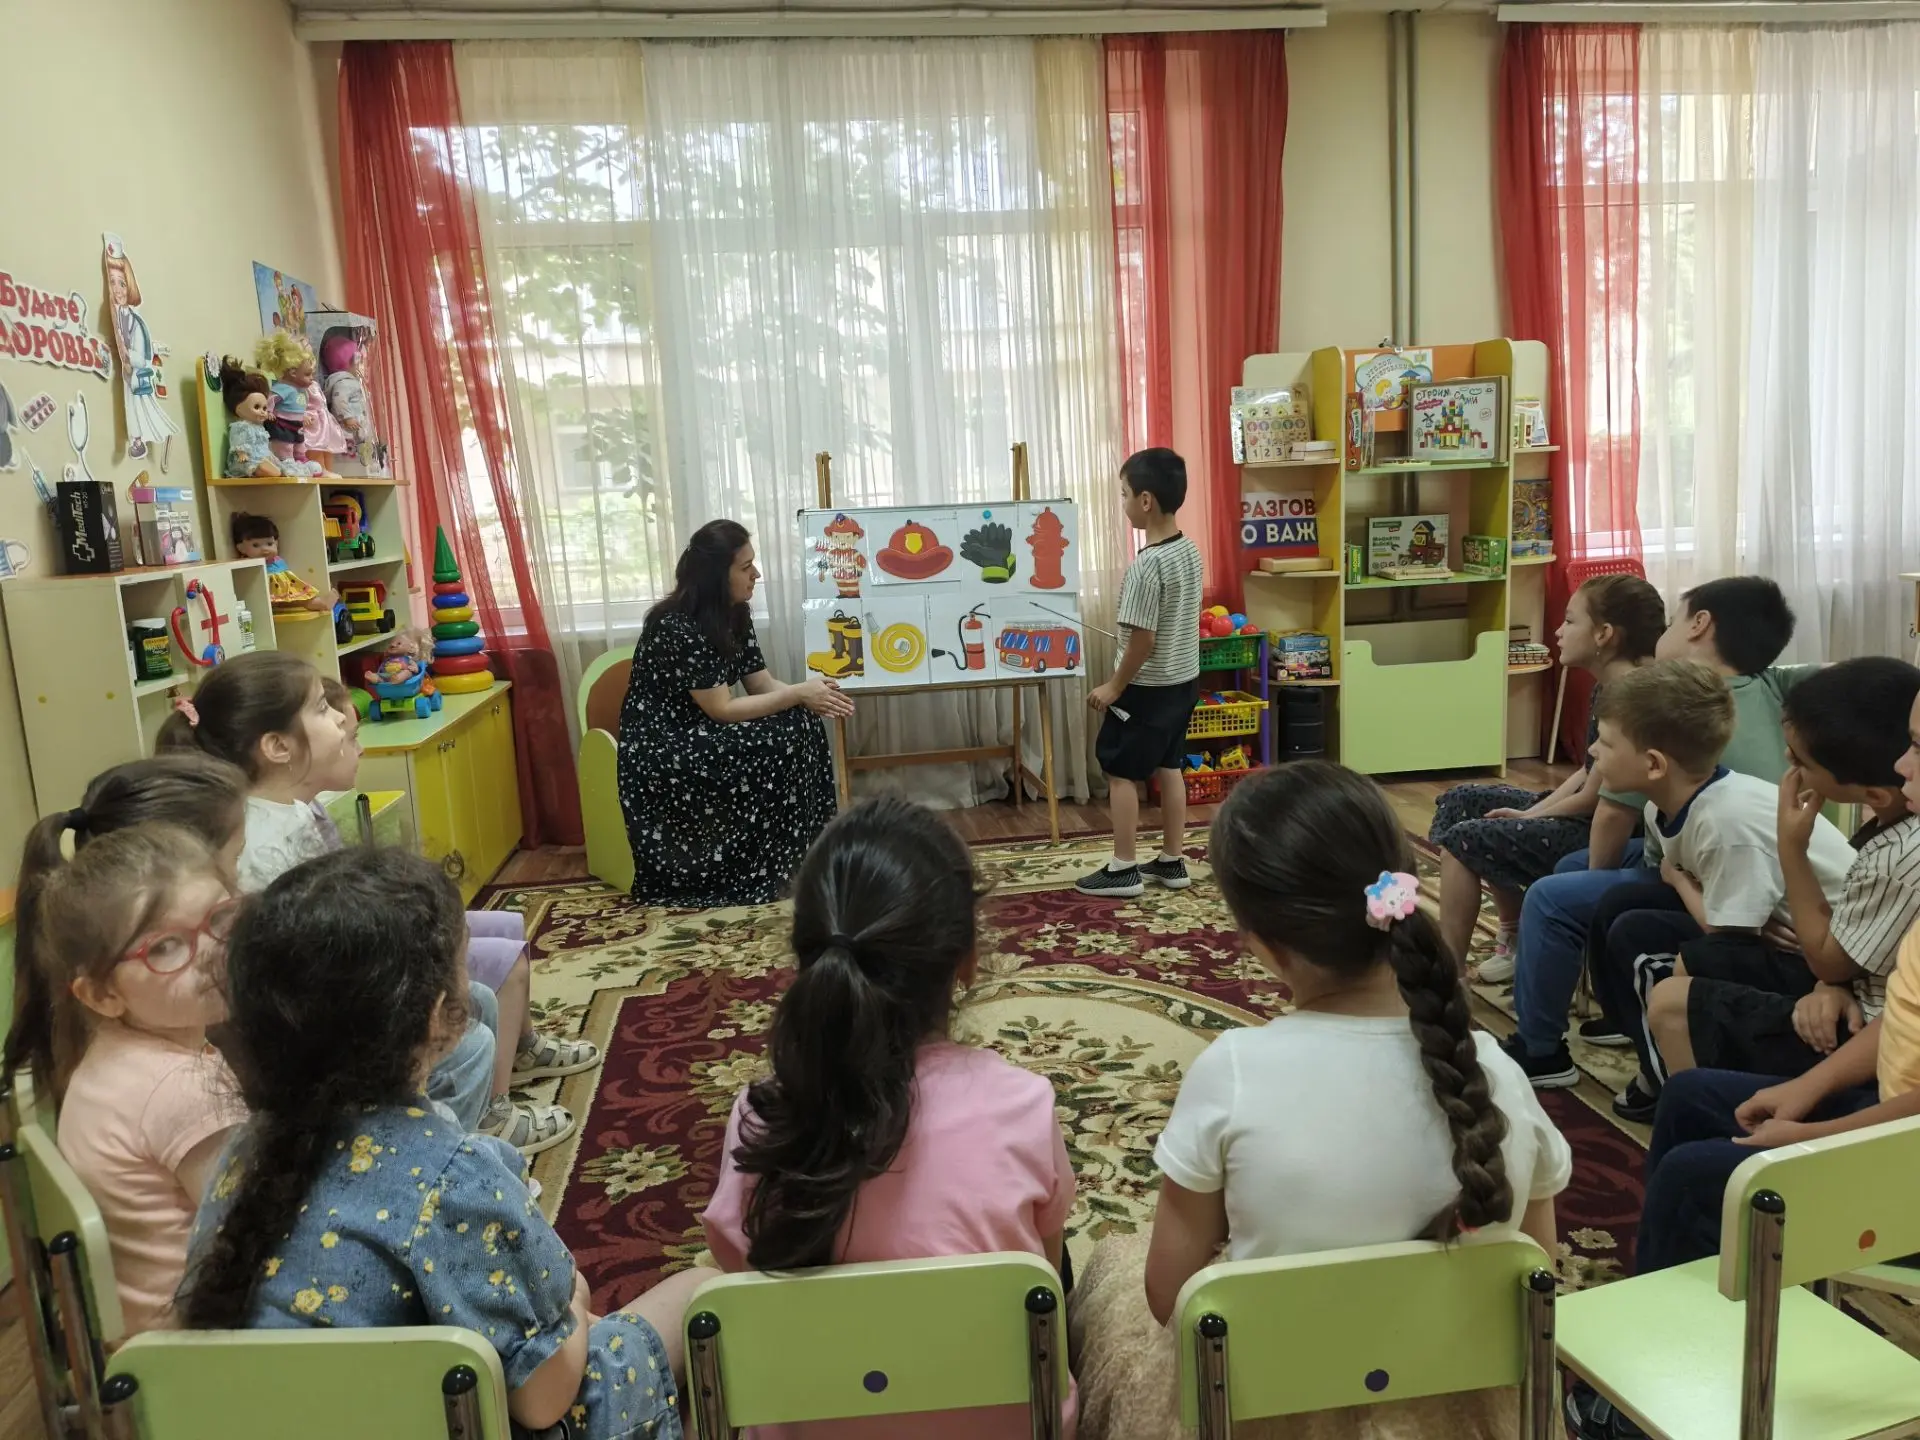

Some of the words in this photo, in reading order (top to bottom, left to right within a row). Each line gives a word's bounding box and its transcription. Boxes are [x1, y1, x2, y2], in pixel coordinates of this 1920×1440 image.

[1264, 448, 1271, 457] 2
[1276, 447, 1283, 456] 3
[1240, 499, 1315, 518] РАЗГОВ
[1241, 524, 1258, 544] О
[1266, 522, 1316, 543] ВАЖ
